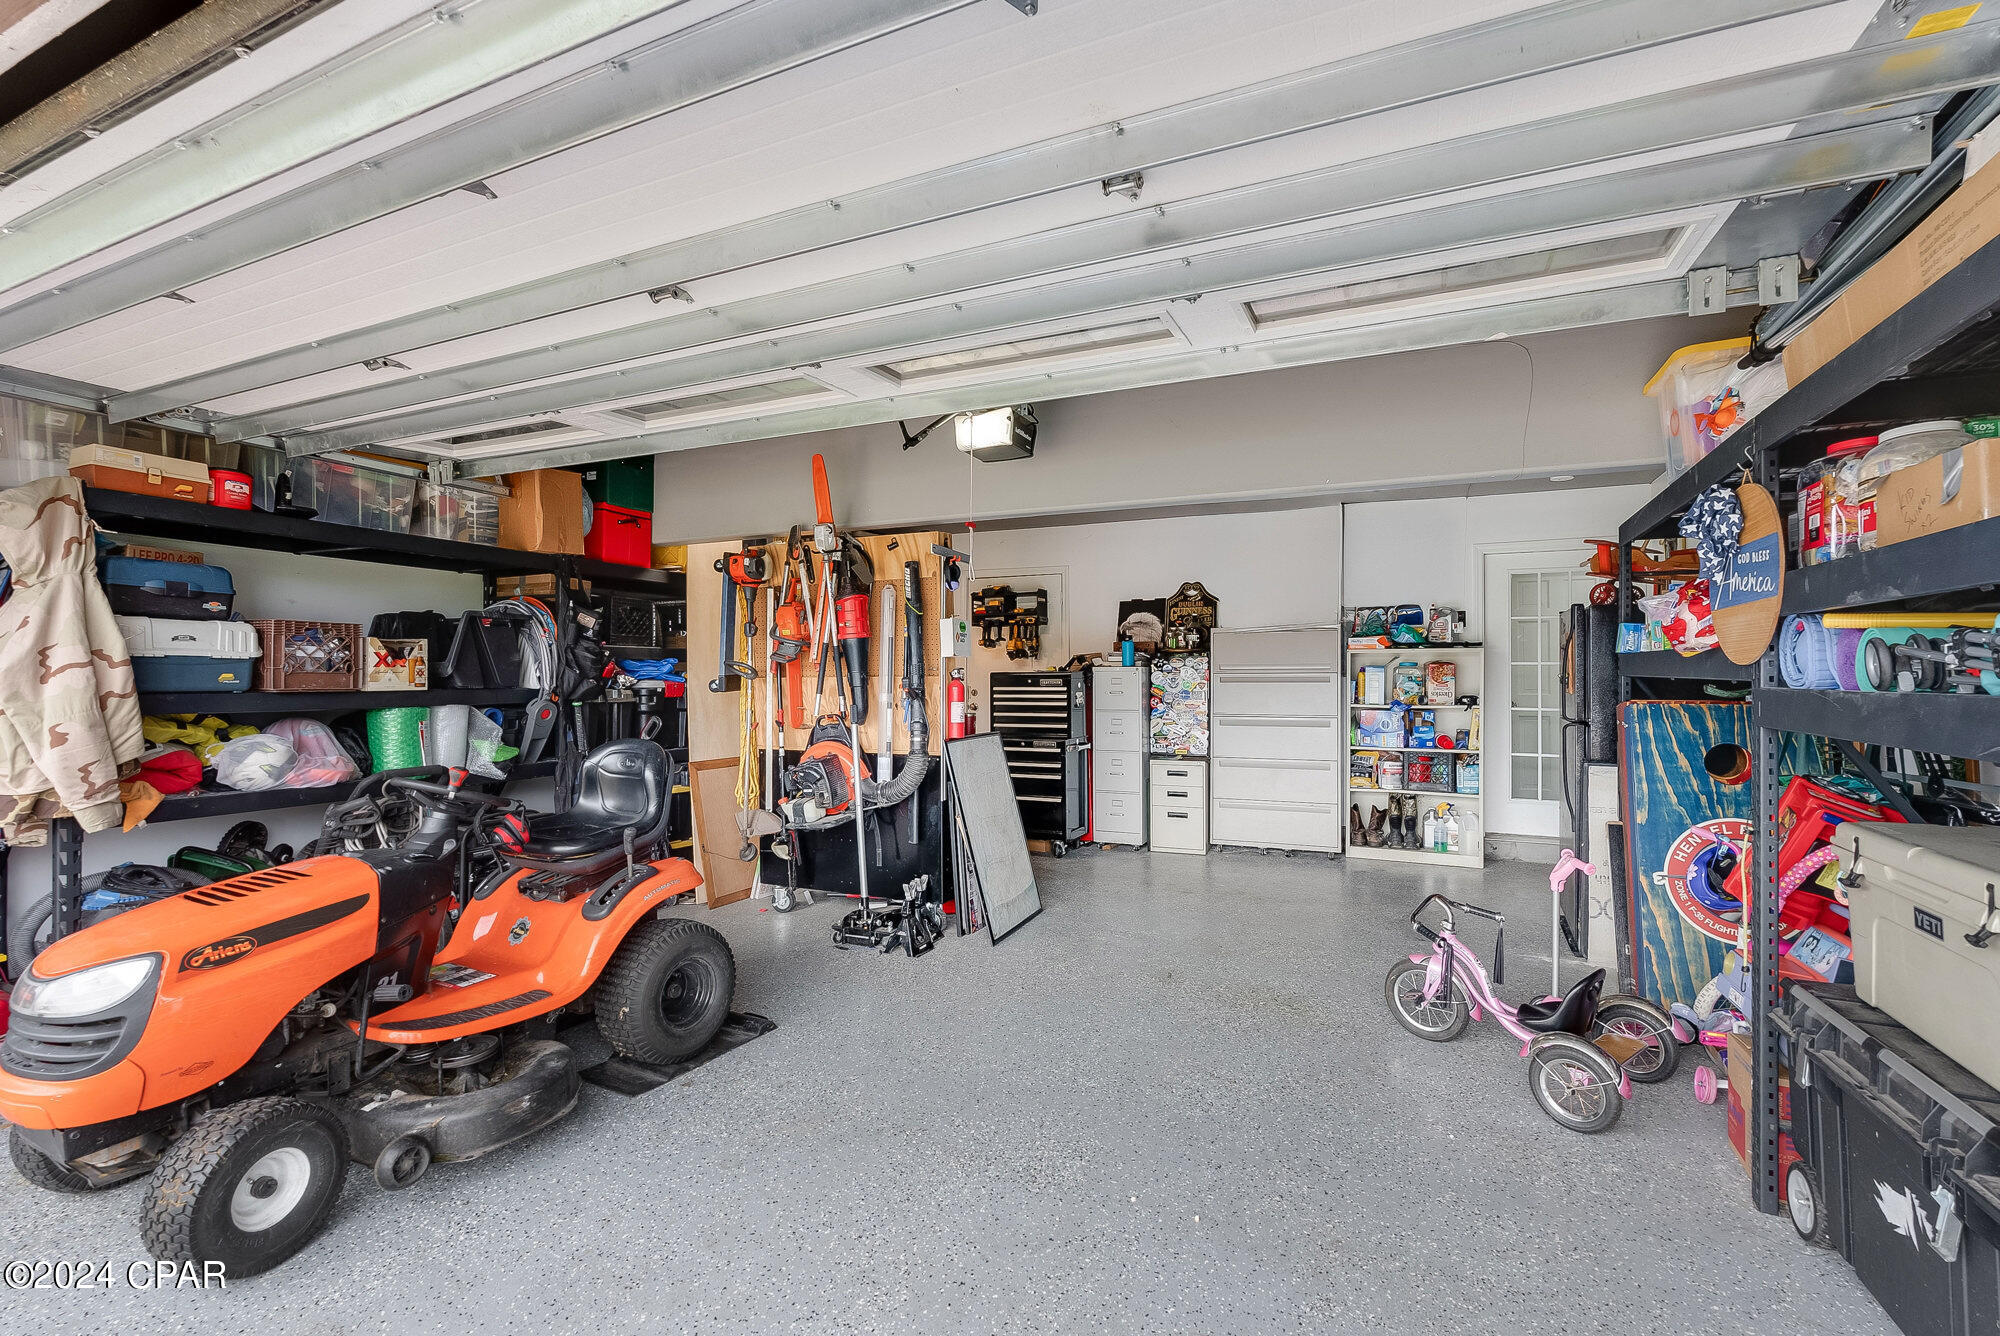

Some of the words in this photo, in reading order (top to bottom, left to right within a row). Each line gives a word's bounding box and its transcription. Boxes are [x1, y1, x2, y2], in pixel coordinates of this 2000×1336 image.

[1973, 423, 1996, 431] 30%
[1737, 552, 1750, 564] GOD
[1752, 550, 1770, 562] BLESS
[1714, 553, 1775, 610] America
[1170, 606, 1213, 621] GUINNESS
[1674, 824, 1733, 862] HENEL
[643, 879, 681, 901] AUTOMATIC
[1675, 880, 1688, 901] ZONE
[1689, 906, 1706, 921] F-35
[1704, 917, 1738, 937] FLIGHTL
[1915, 911, 1942, 936] YETI
[190, 940, 252, 967] Ariens
